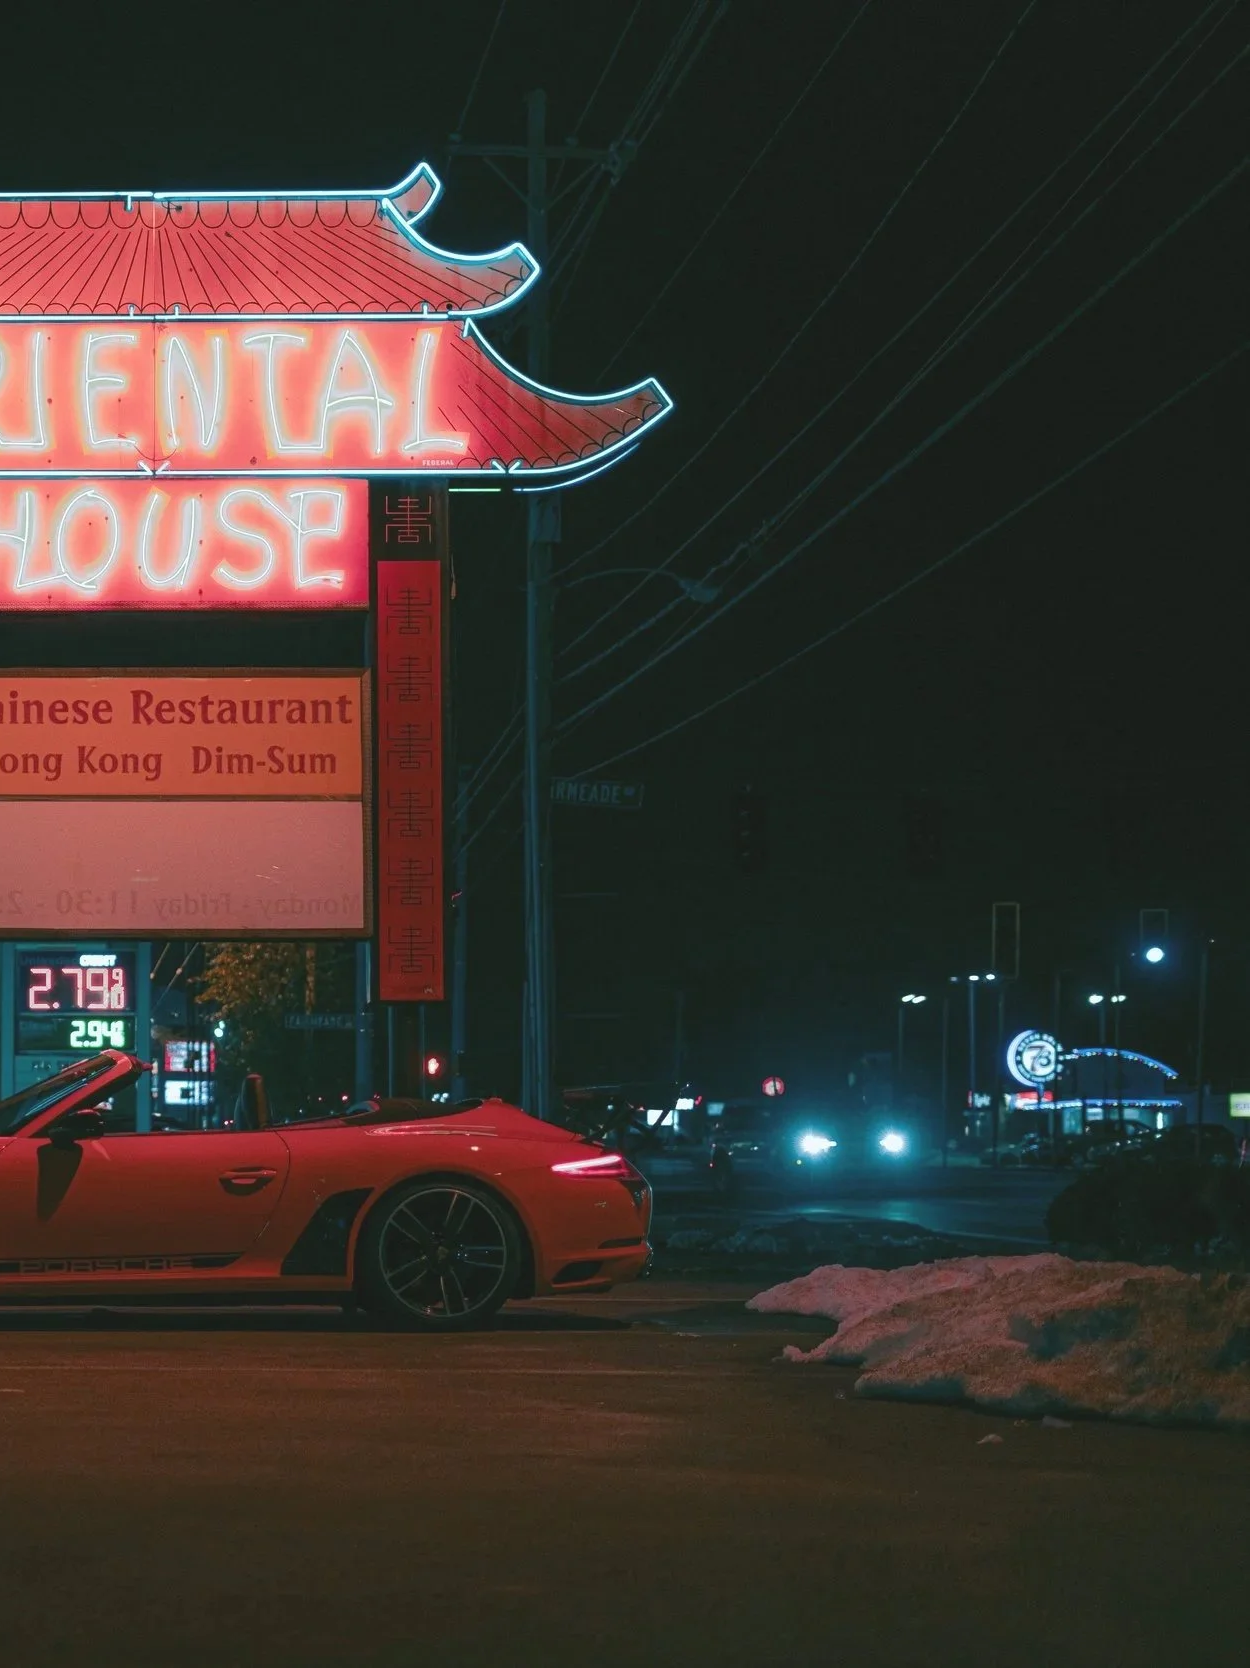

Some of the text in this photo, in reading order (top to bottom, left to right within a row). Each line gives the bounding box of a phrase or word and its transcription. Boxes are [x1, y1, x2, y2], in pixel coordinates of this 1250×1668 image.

[422, 459, 455, 467] FEDERAL
[132, 690, 354, 728] Restaurant
[77, 746, 163, 782] Kong
[192, 746, 338, 776] Dim-Sum
[19, 1256, 193, 1275] PORSCHE
